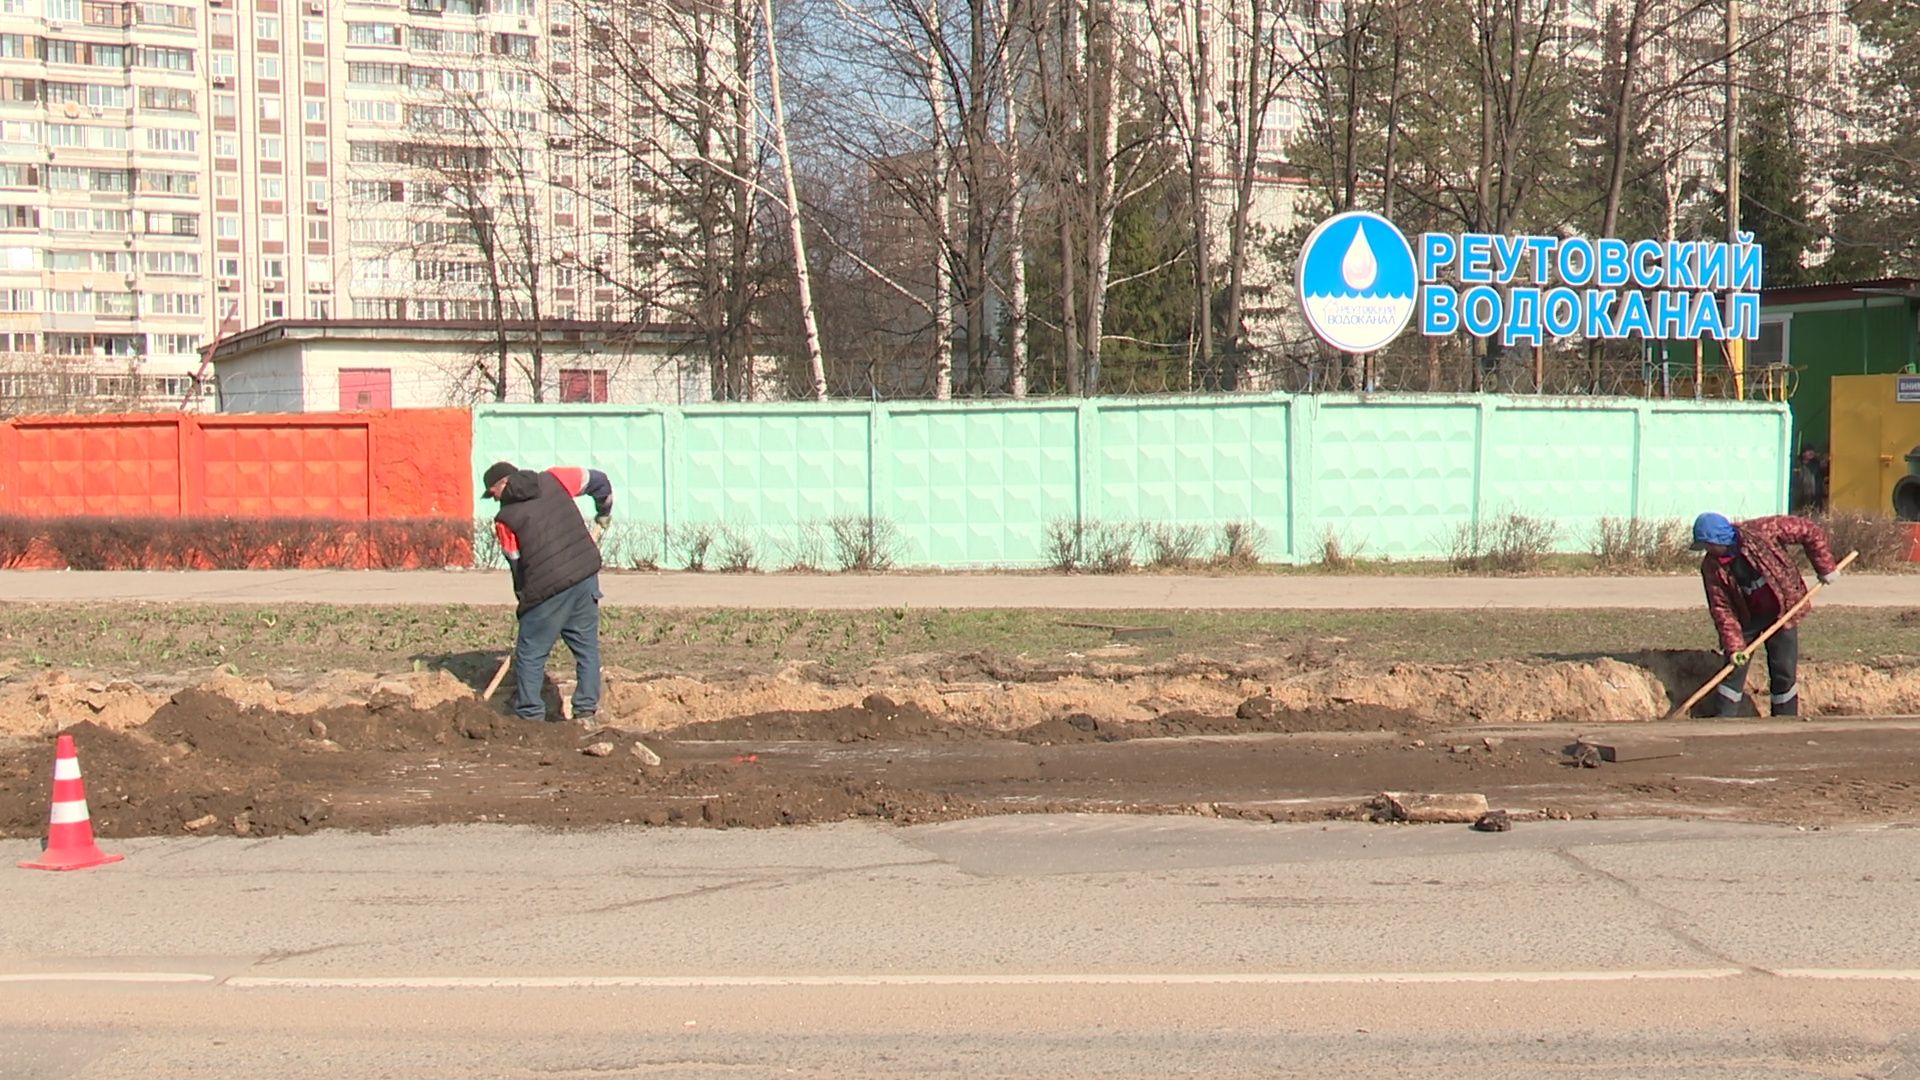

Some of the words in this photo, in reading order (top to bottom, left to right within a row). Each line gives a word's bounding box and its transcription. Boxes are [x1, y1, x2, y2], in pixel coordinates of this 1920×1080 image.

[1423, 231, 1762, 290] РЕУТОВСКИЙ
[1327, 314, 1396, 325] ВОДОКАНАЛ
[1423, 285, 1760, 346] ВОДОКАНАЛ
